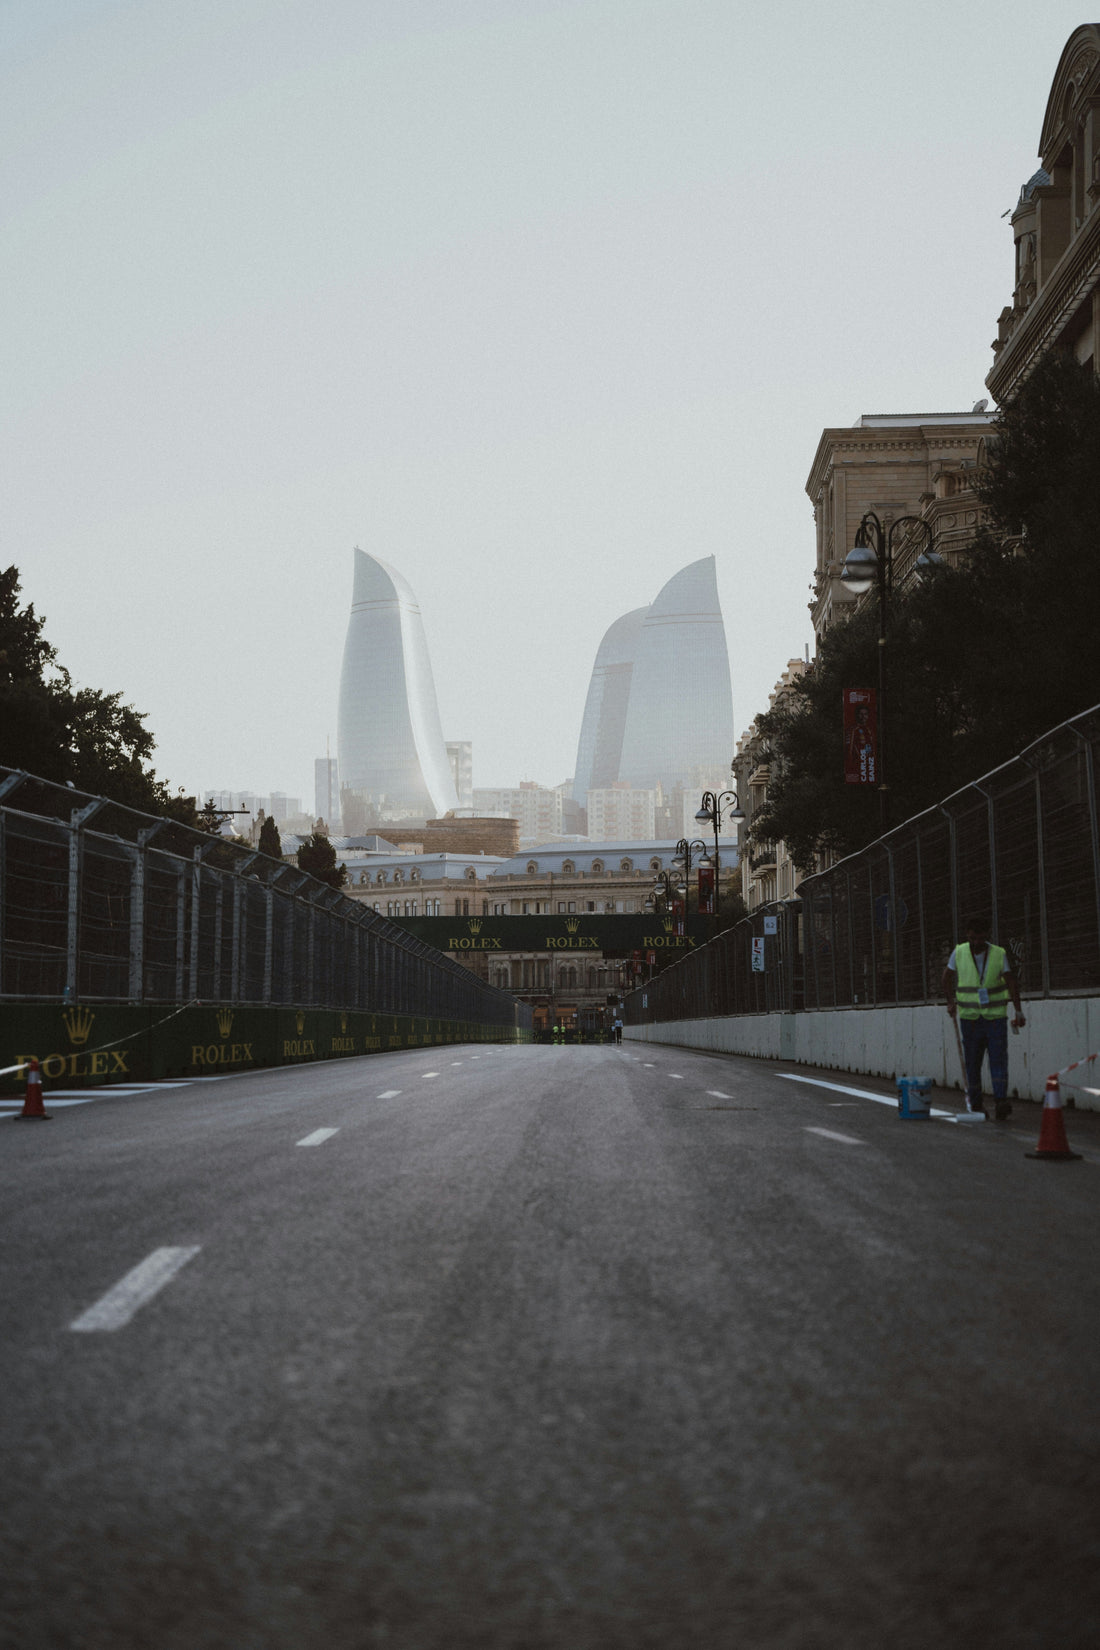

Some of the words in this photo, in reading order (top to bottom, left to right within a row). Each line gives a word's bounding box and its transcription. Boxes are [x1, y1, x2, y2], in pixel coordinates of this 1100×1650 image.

[449, 938, 502, 949] ROLEX
[546, 937, 599, 948] ROLEX
[643, 936, 696, 947] ROLEX
[283, 1039, 315, 1057] ROLEX
[331, 1037, 355, 1051] ROLEX
[192, 1043, 254, 1065] ROLEX
